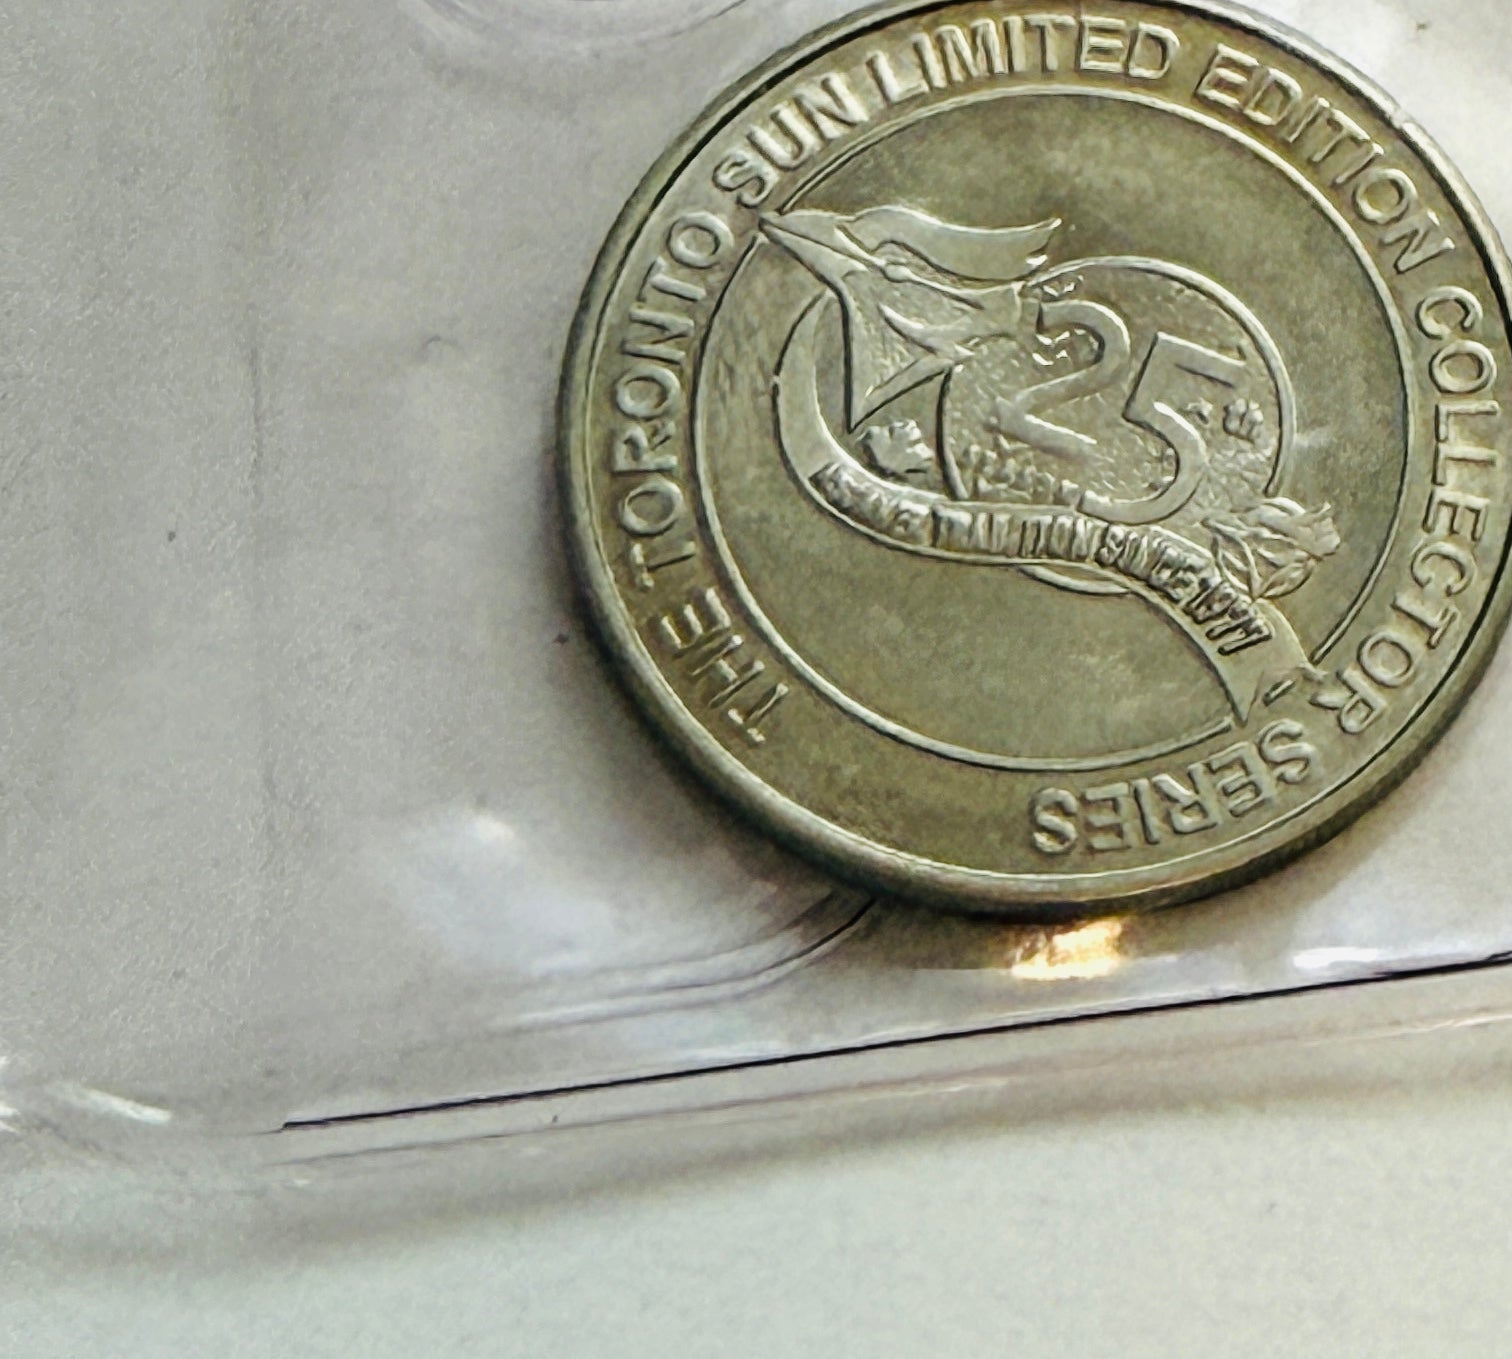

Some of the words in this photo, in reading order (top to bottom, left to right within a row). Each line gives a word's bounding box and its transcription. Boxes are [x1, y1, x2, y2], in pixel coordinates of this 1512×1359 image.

[865, 12, 1182, 105] LIMITED
[711, 70, 870, 210] SUN
[1194, 42, 1456, 275] EDITION
[612, 211, 735, 591] TORONTO
[1308, 284, 1501, 737] COLLECTOR
[659, 586, 790, 746] THE
[1028, 717, 1323, 856] SERIES
